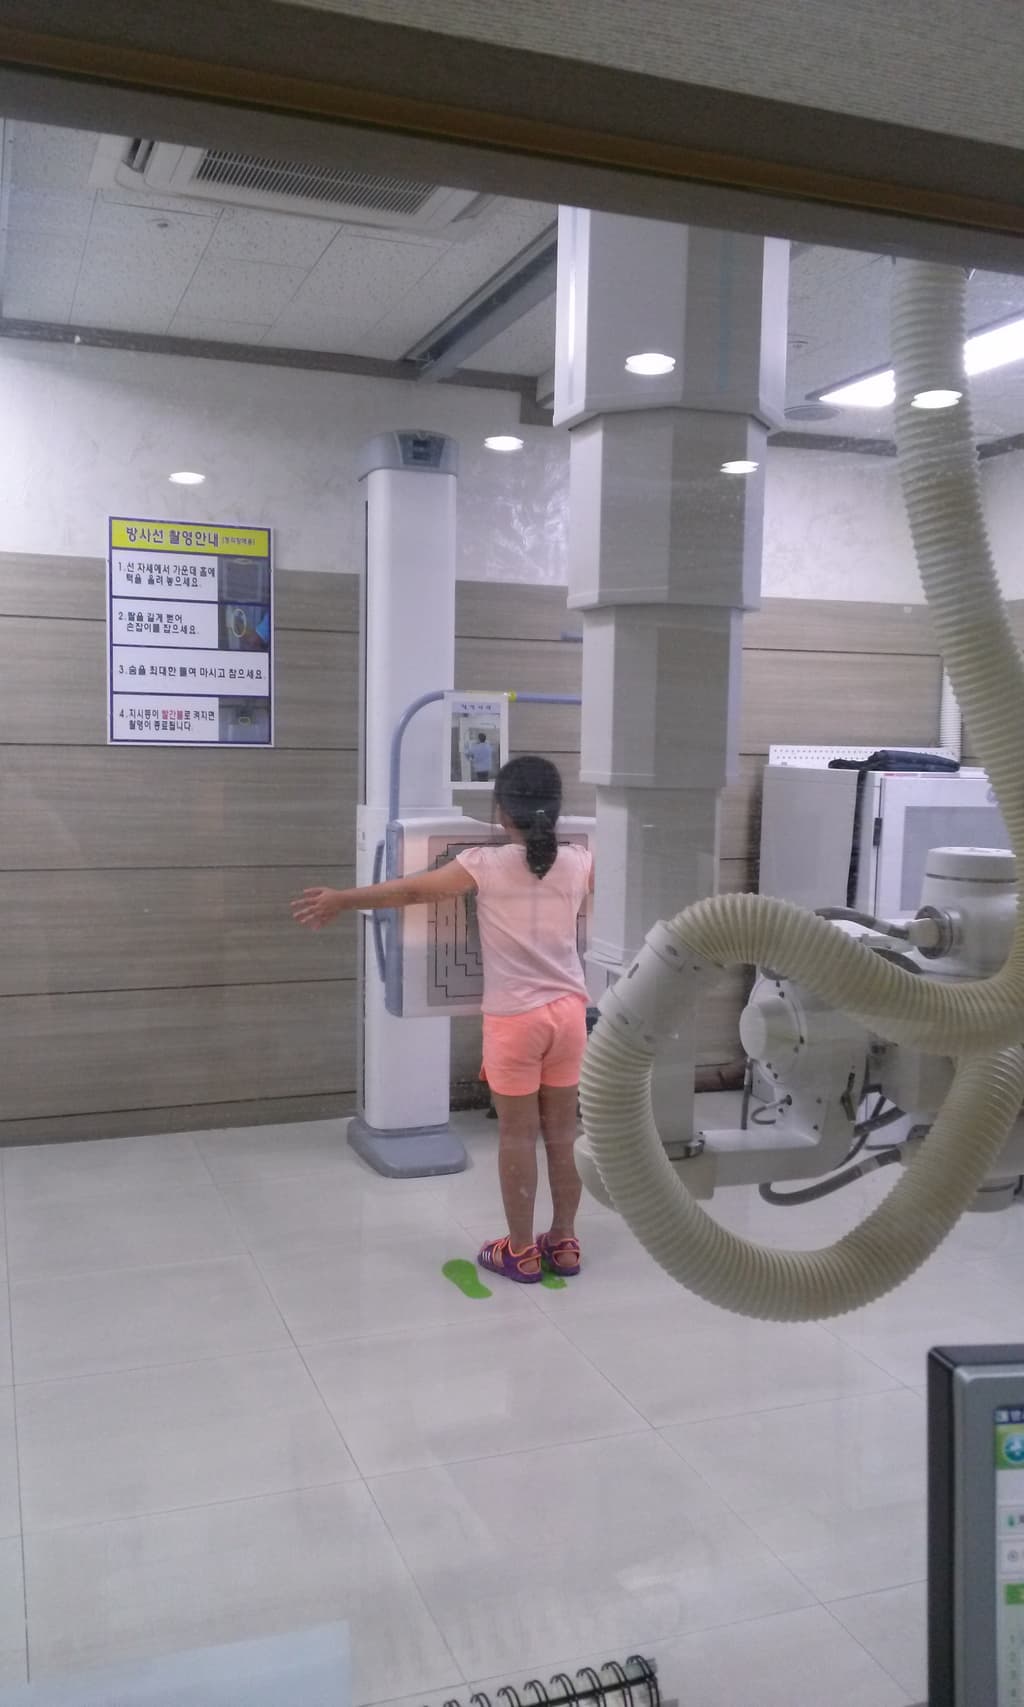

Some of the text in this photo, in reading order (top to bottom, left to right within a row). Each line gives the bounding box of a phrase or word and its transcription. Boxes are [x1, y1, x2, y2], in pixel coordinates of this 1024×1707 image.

[126, 526, 164, 543] 방사선
[169, 529, 219, 547] 촬영안내
[173, 565, 197, 577] 가운데
[148, 575, 164, 586] 올려
[147, 612, 163, 623] 길게
[126, 622, 160, 633] 손잡이를
[149, 665, 177, 677] 최대한
[199, 667, 226, 679] 마시고
